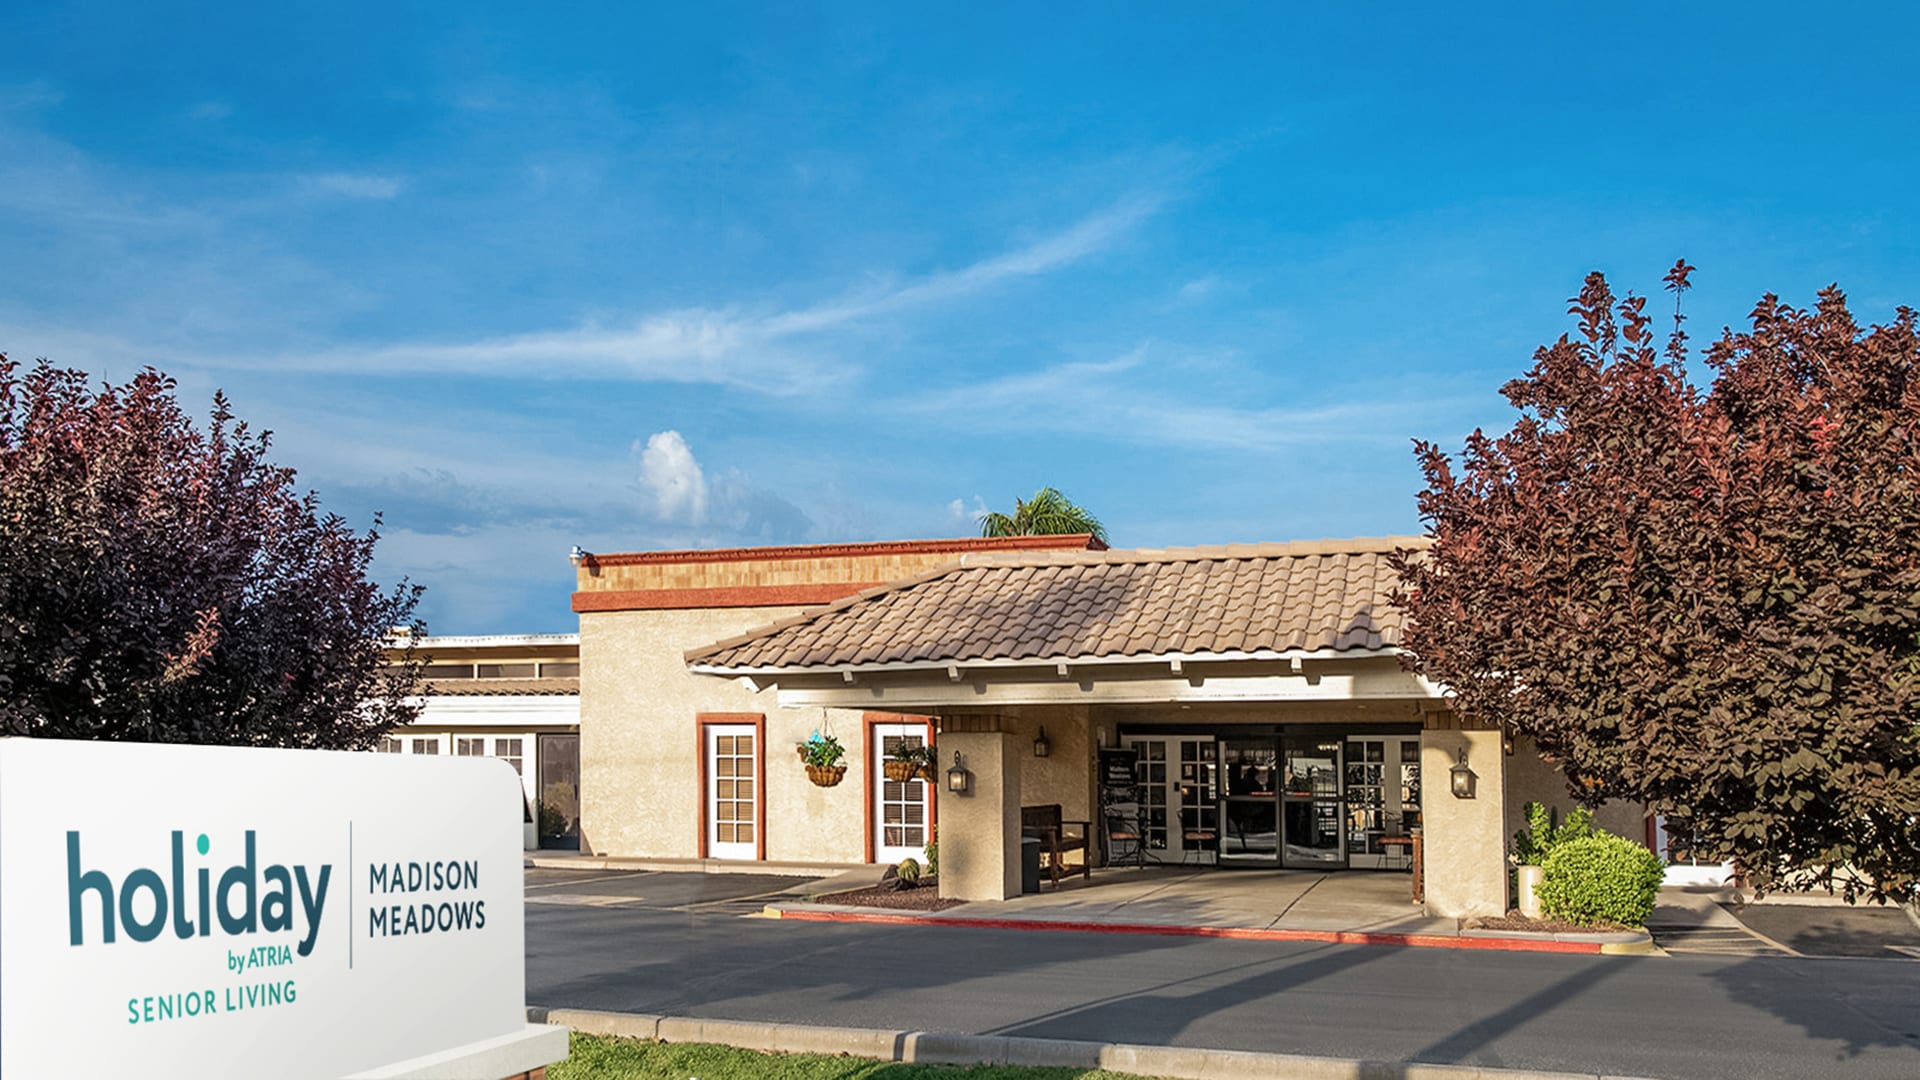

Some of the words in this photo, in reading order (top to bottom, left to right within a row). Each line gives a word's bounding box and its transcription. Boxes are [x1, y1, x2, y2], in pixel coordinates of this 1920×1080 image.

[66, 829, 333, 957] holiday
[369, 860, 479, 895] MADISON
[369, 900, 486, 939] MEADOWS
[227, 949, 246, 975] by
[246, 944, 294, 969] ATRIA
[127, 987, 217, 1025] SENIOR
[225, 979, 297, 1012] LIVING
